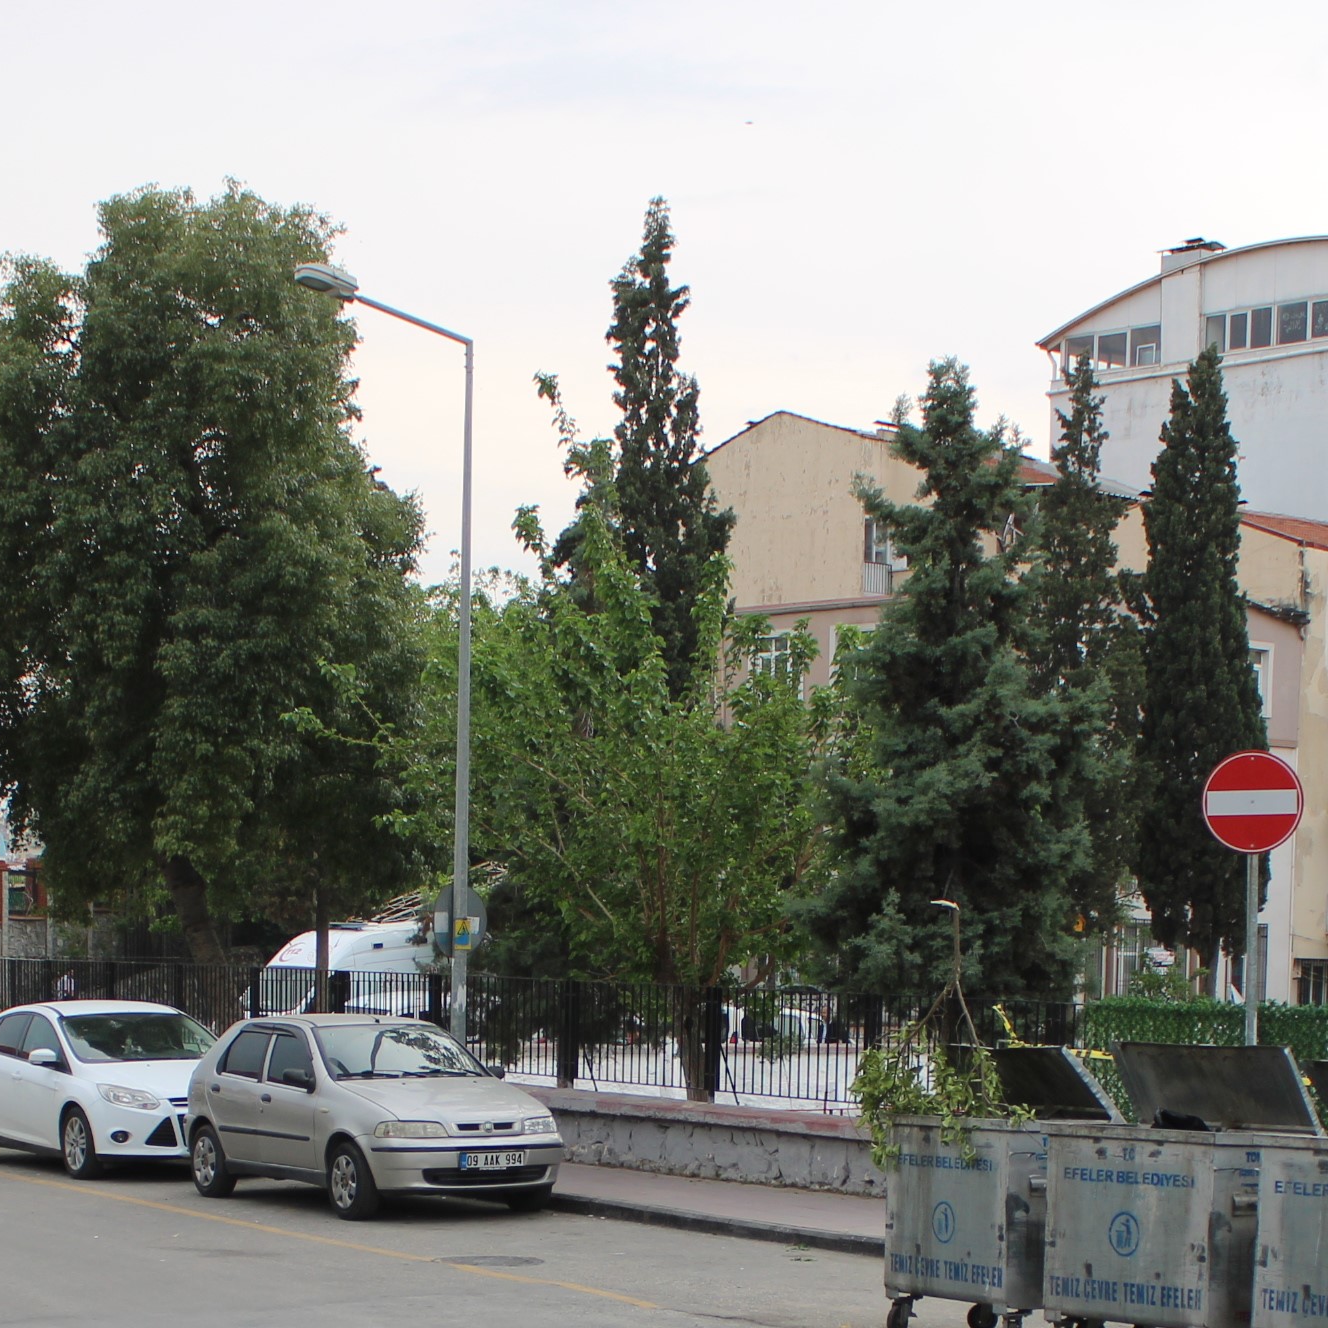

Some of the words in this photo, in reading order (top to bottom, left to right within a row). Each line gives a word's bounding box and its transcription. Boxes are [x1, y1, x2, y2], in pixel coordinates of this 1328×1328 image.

[467, 1155, 478, 1166] 09
[484, 1154, 500, 1166] AAK
[506, 1153, 522, 1165] 994
[1063, 1166, 1114, 1183] EFELER
